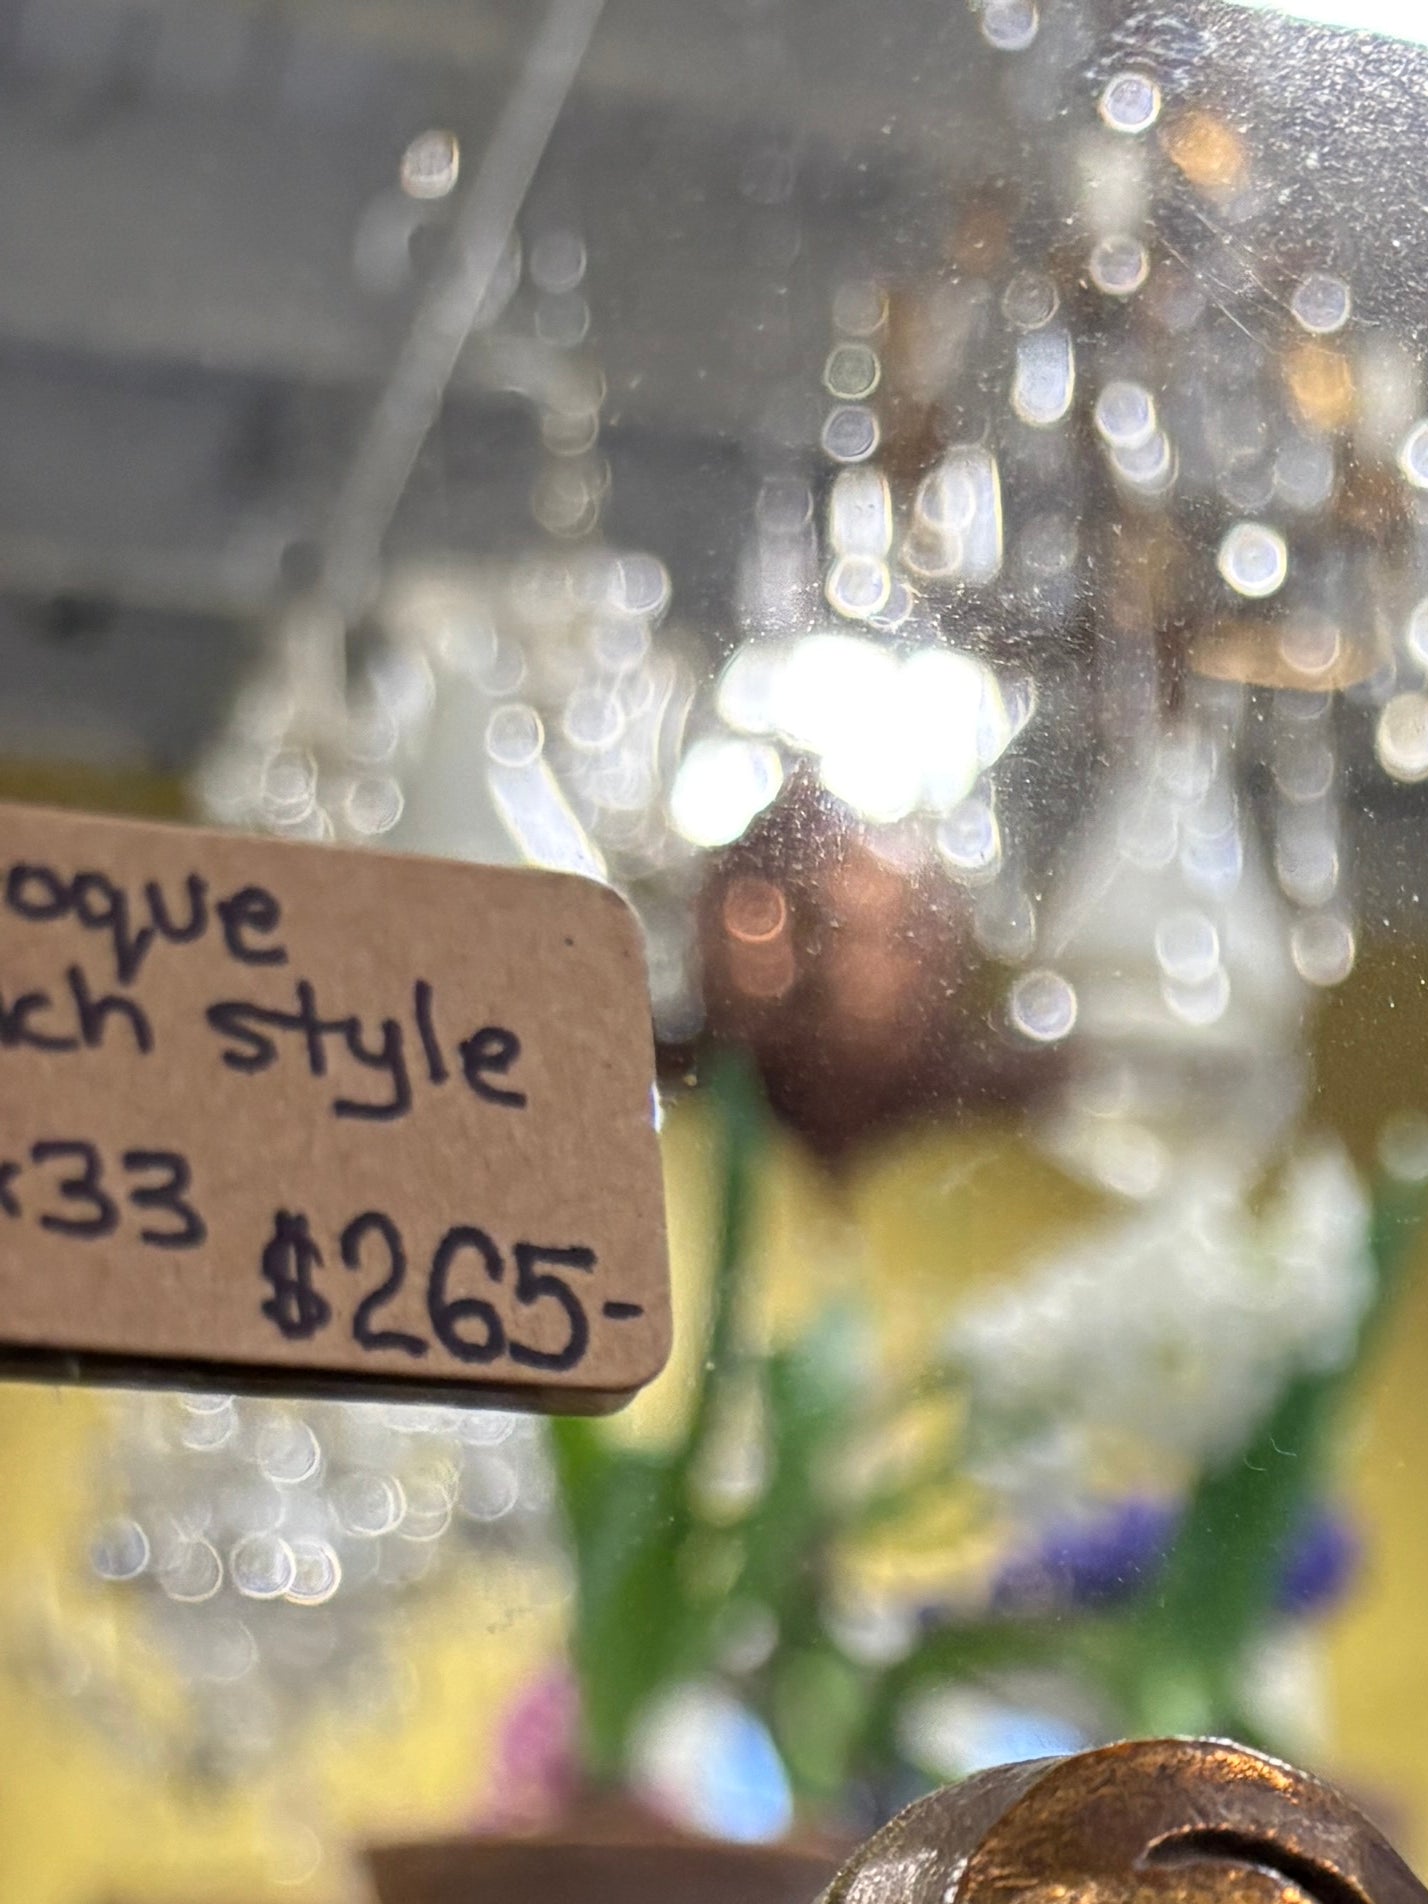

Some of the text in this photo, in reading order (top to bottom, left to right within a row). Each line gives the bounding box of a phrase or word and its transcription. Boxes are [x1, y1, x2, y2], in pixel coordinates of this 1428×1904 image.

[0, 964, 528, 1120] ch style
[260, 1209, 645, 1371] $265-
